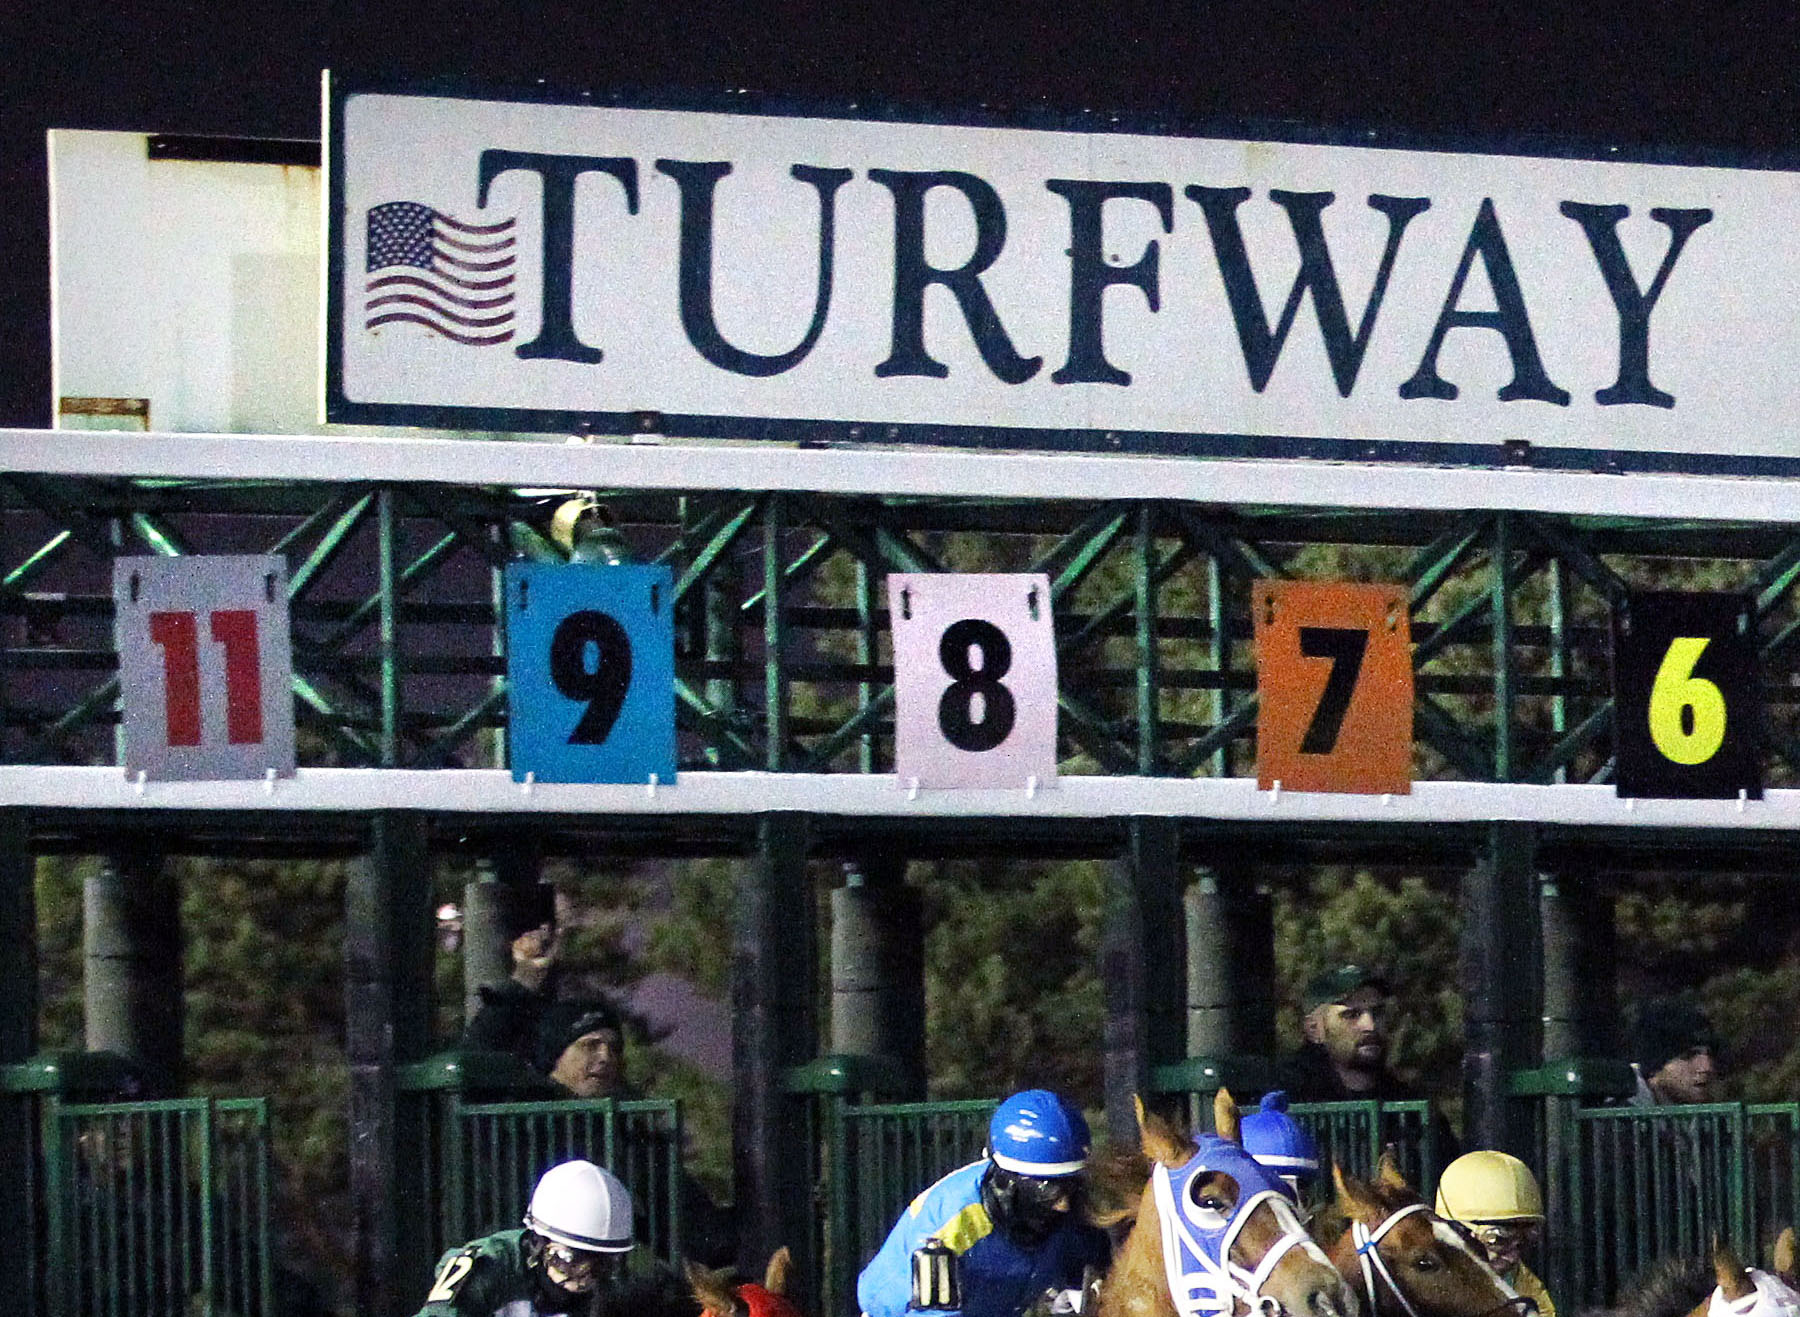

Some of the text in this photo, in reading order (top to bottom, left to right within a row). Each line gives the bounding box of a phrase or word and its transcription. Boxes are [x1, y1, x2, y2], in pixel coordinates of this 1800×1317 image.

[477, 148, 1714, 410] TURFWAY
[151, 610, 262, 745] 11
[549, 609, 633, 746] 9
[938, 619, 1017, 752] 8
[1298, 626, 1370, 755] 7
[1648, 637, 1727, 765] 6
